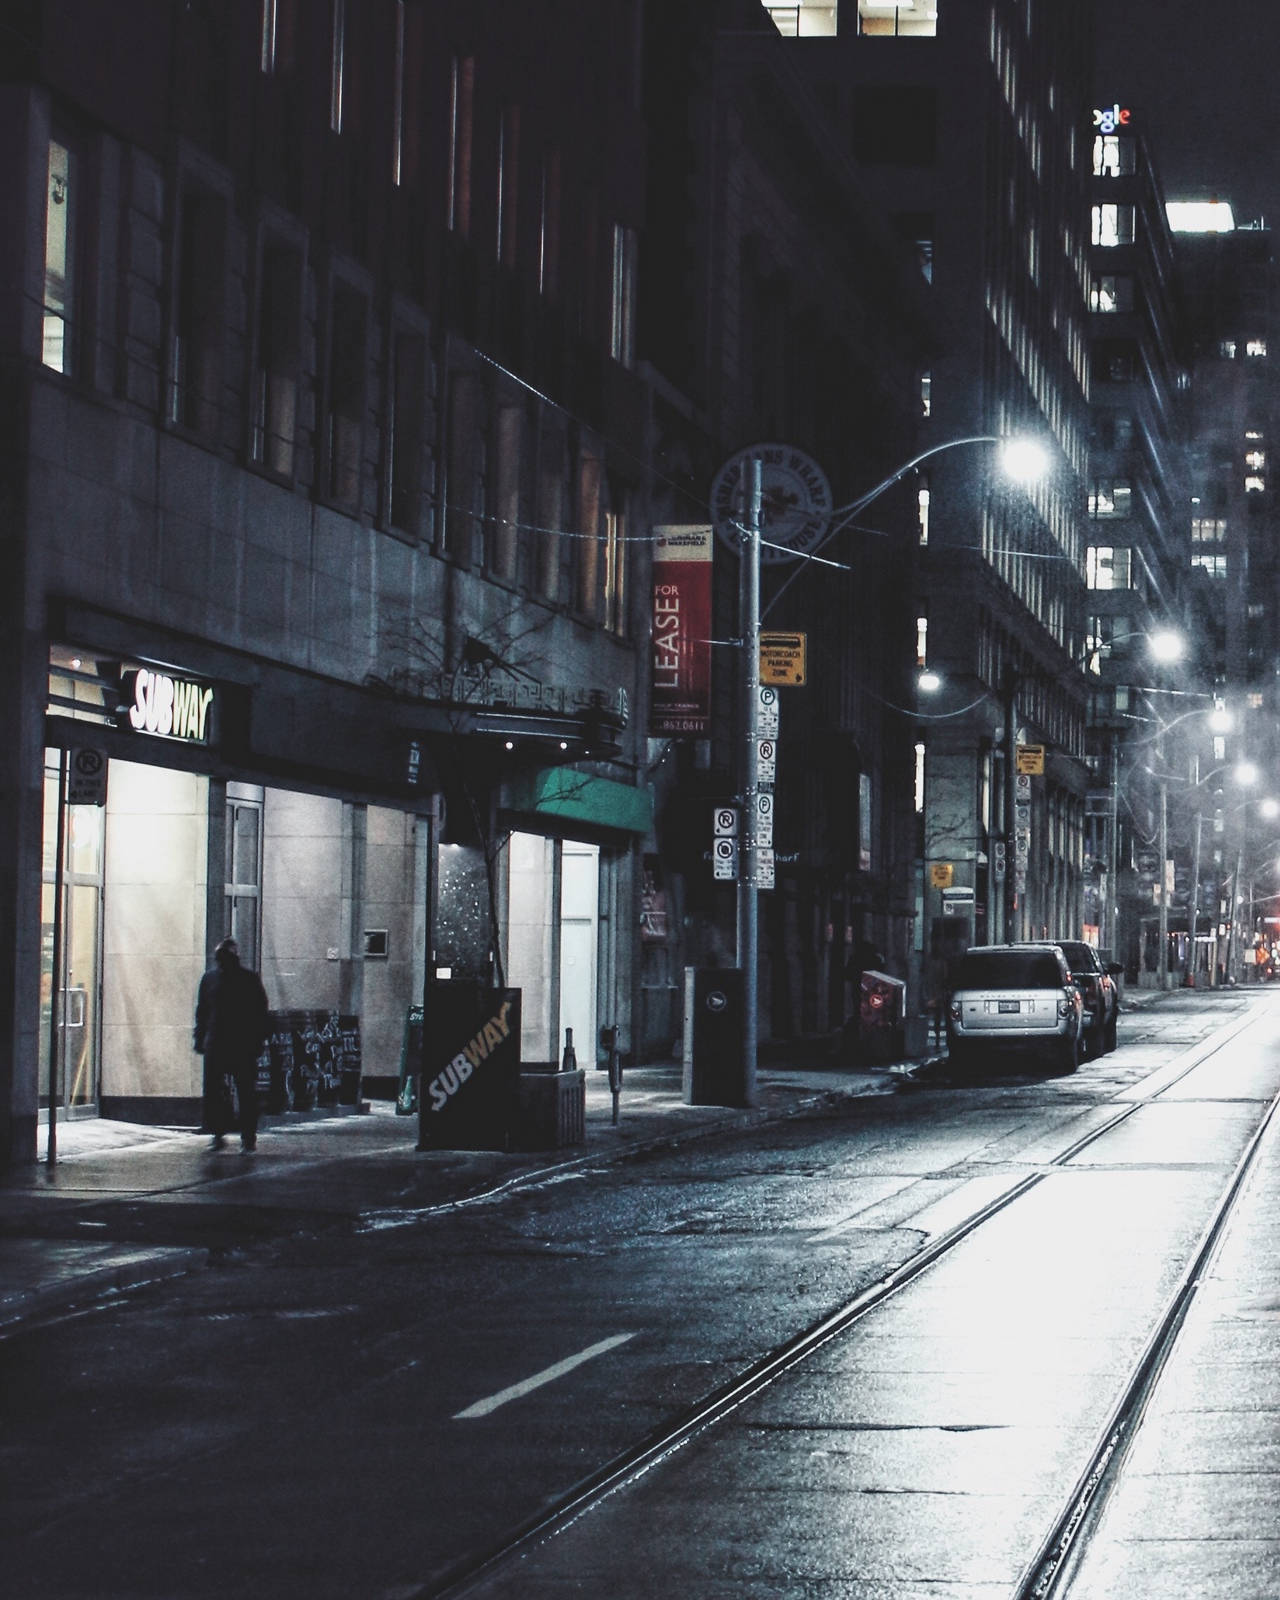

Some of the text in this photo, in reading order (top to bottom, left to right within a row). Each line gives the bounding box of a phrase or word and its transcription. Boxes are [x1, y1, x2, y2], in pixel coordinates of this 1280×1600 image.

[1093, 104, 1130, 133] ogle
[655, 585, 679, 595] FOR
[654, 598, 680, 687] LEASE
[768, 659, 792, 667] PARKING
[129, 668, 213, 740] SUBWAY
[429, 1001, 512, 1112] SUBWAY
